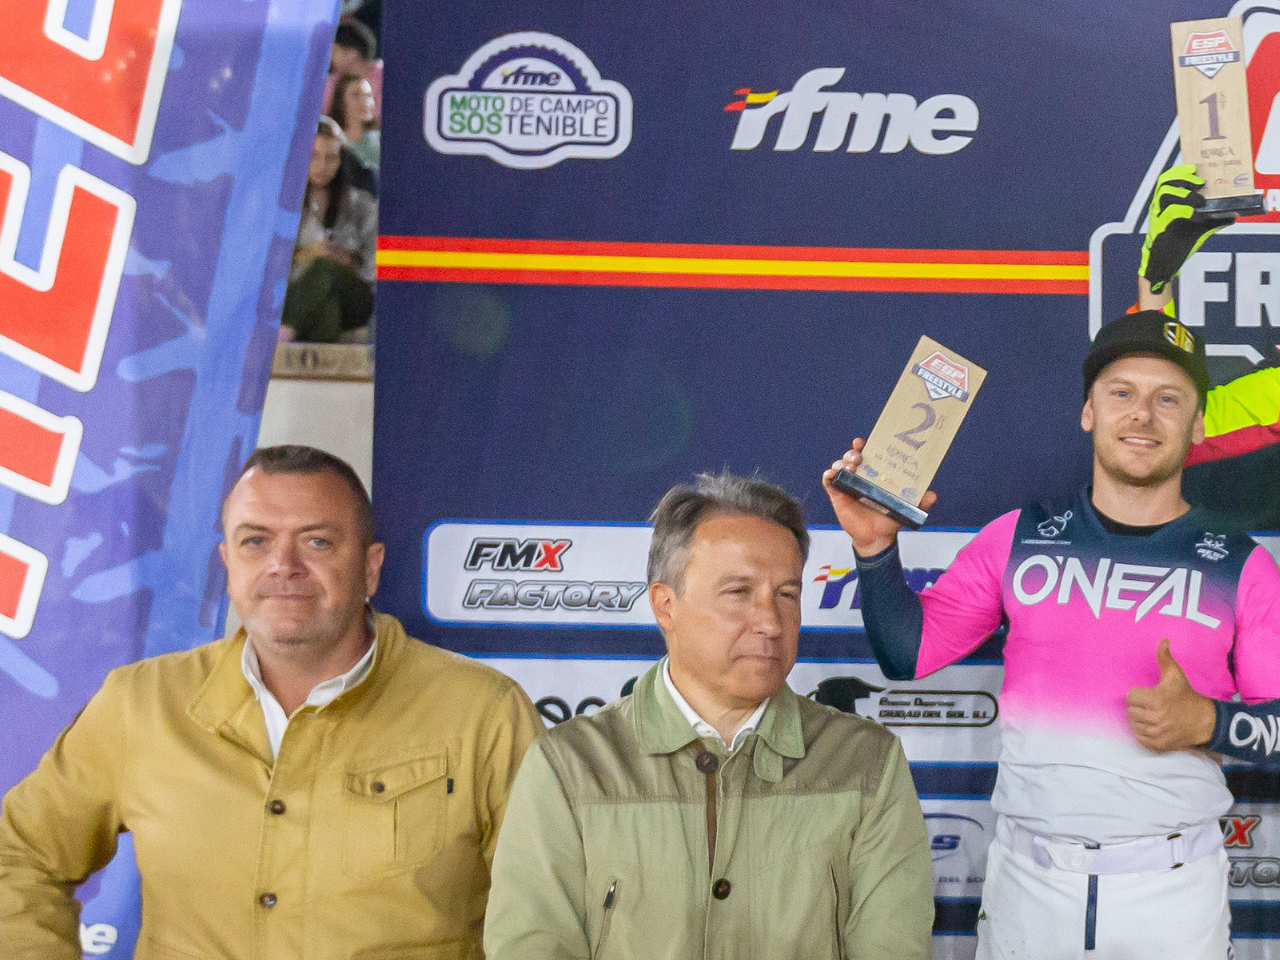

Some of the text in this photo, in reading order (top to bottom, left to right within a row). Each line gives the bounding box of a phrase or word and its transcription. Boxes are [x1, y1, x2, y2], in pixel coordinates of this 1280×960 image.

[501, 64, 561, 87] rfme
[449, 95, 608, 115] MOTO DE CAMPO
[724, 67, 980, 155] rfme
[1199, 92, 1226, 140] 1
[449, 113, 607, 137] SOSTENIBLE
[894, 402, 936, 450] 2
[466, 539, 571, 571] FMX
[464, 580, 646, 611] FACTORY
[1013, 553, 1221, 629] O'NEAL
